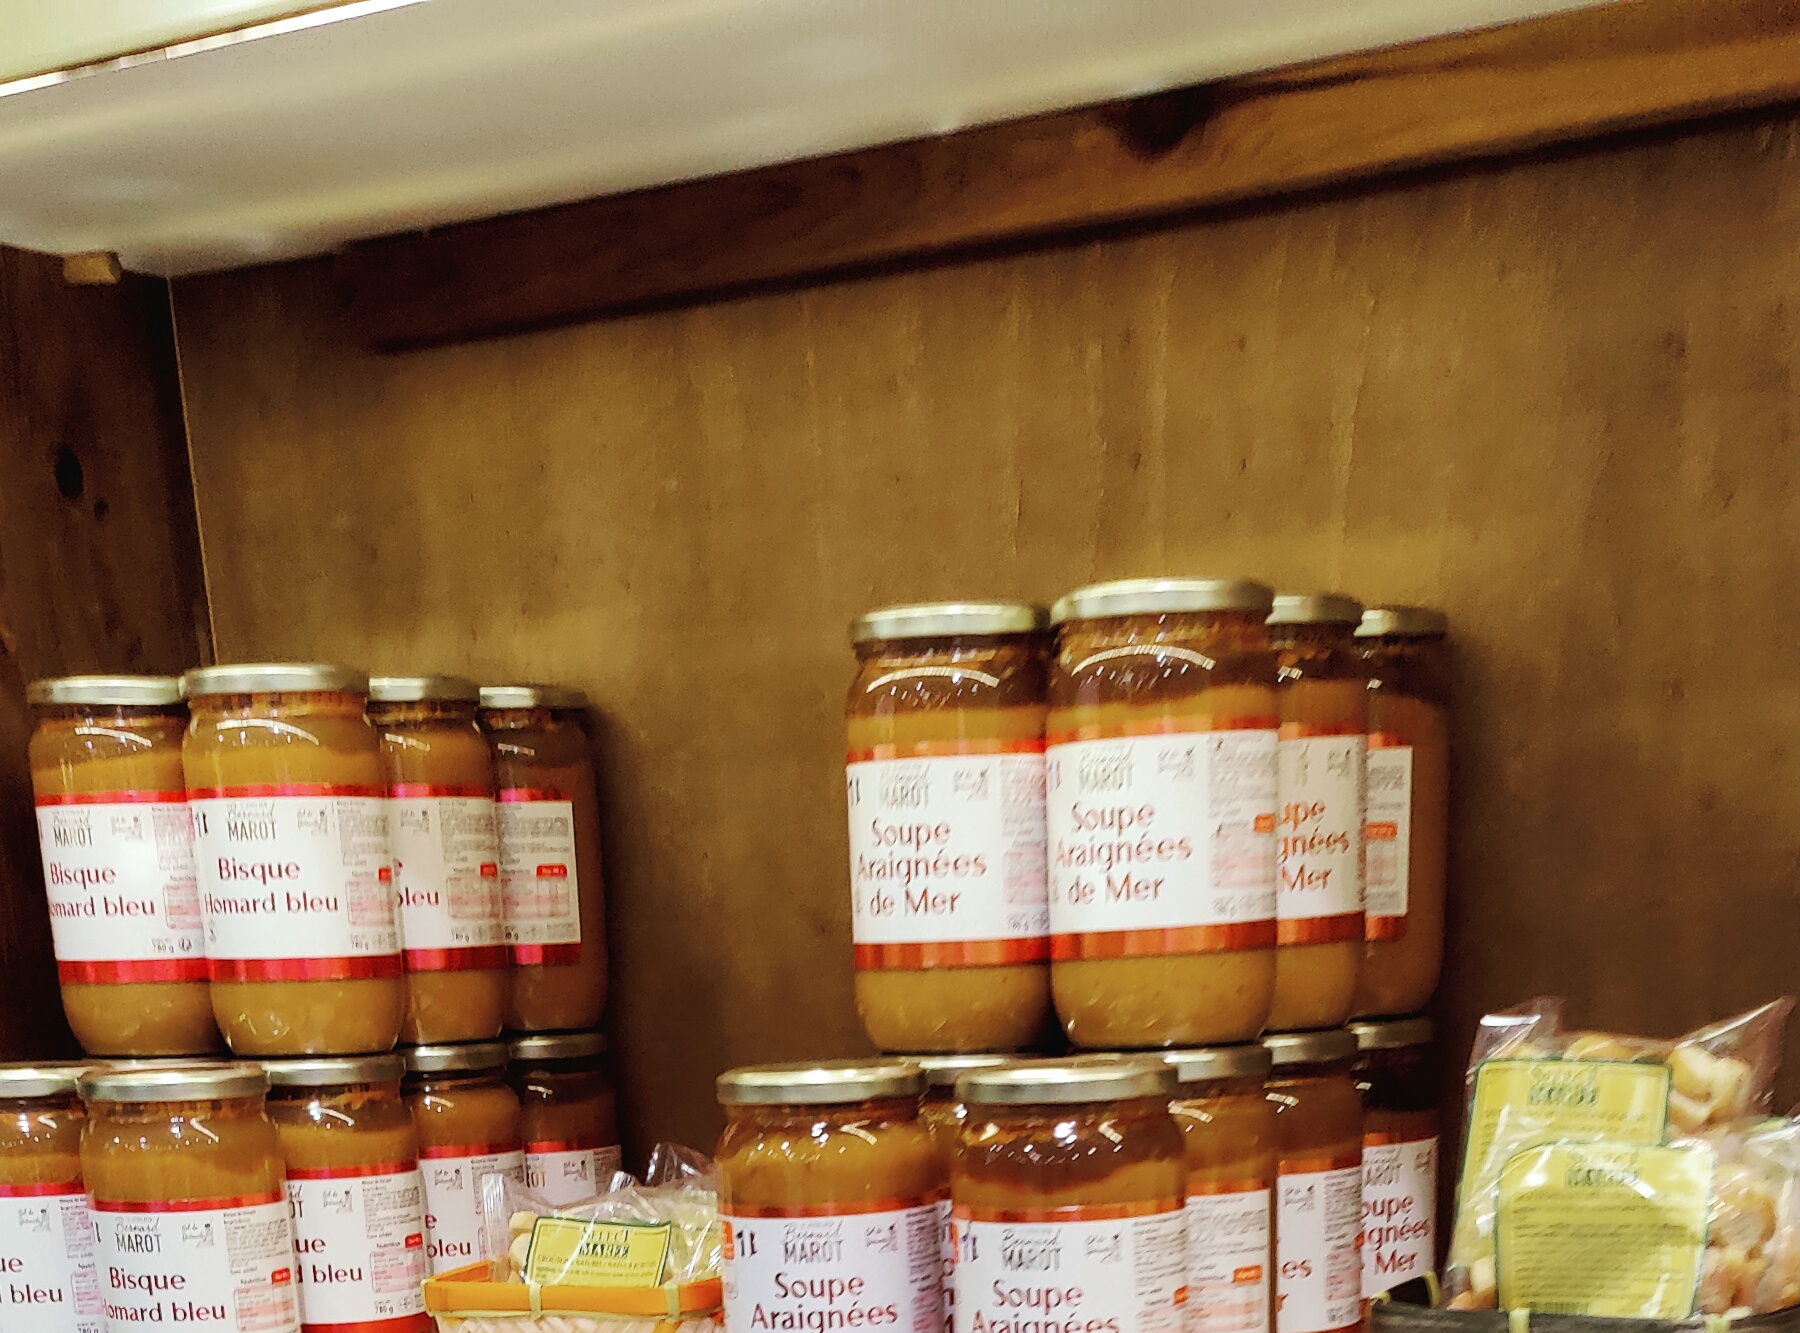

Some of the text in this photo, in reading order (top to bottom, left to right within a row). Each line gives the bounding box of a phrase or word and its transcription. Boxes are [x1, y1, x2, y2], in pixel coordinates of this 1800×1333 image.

[1072, 802, 1155, 835] Soupe
[1281, 800, 1326, 825] upe
[871, 817, 951, 852] Soupe
[1281, 827, 1350, 862] gnées
[1056, 831, 1194, 873] Araignées
[50, 862, 116, 891] Bisque
[217, 857, 301, 885] Bisque
[857, 849, 988, 887] Araignées
[869, 886, 961, 917] de Mer
[1067, 870, 1165, 905] de Mer
[50, 895, 155, 918] omard bleu
[204, 890, 339, 915] Homard bleu
[1362, 1195, 1414, 1222] oupe
[114, 1231, 162, 1254] MAROT
[1367, 1216, 1430, 1251] gnées
[783, 1239, 844, 1264] MAROT
[1374, 1250, 1418, 1275] Mer
[109, 1266, 186, 1296] Bisque
[312, 1264, 363, 1283] bleu
[774, 1272, 865, 1304] Soupe
[10, 1284, 63, 1304] bleu
[992, 1278, 1084, 1316] Soupe
[171, 1301, 226, 1321] bleu
